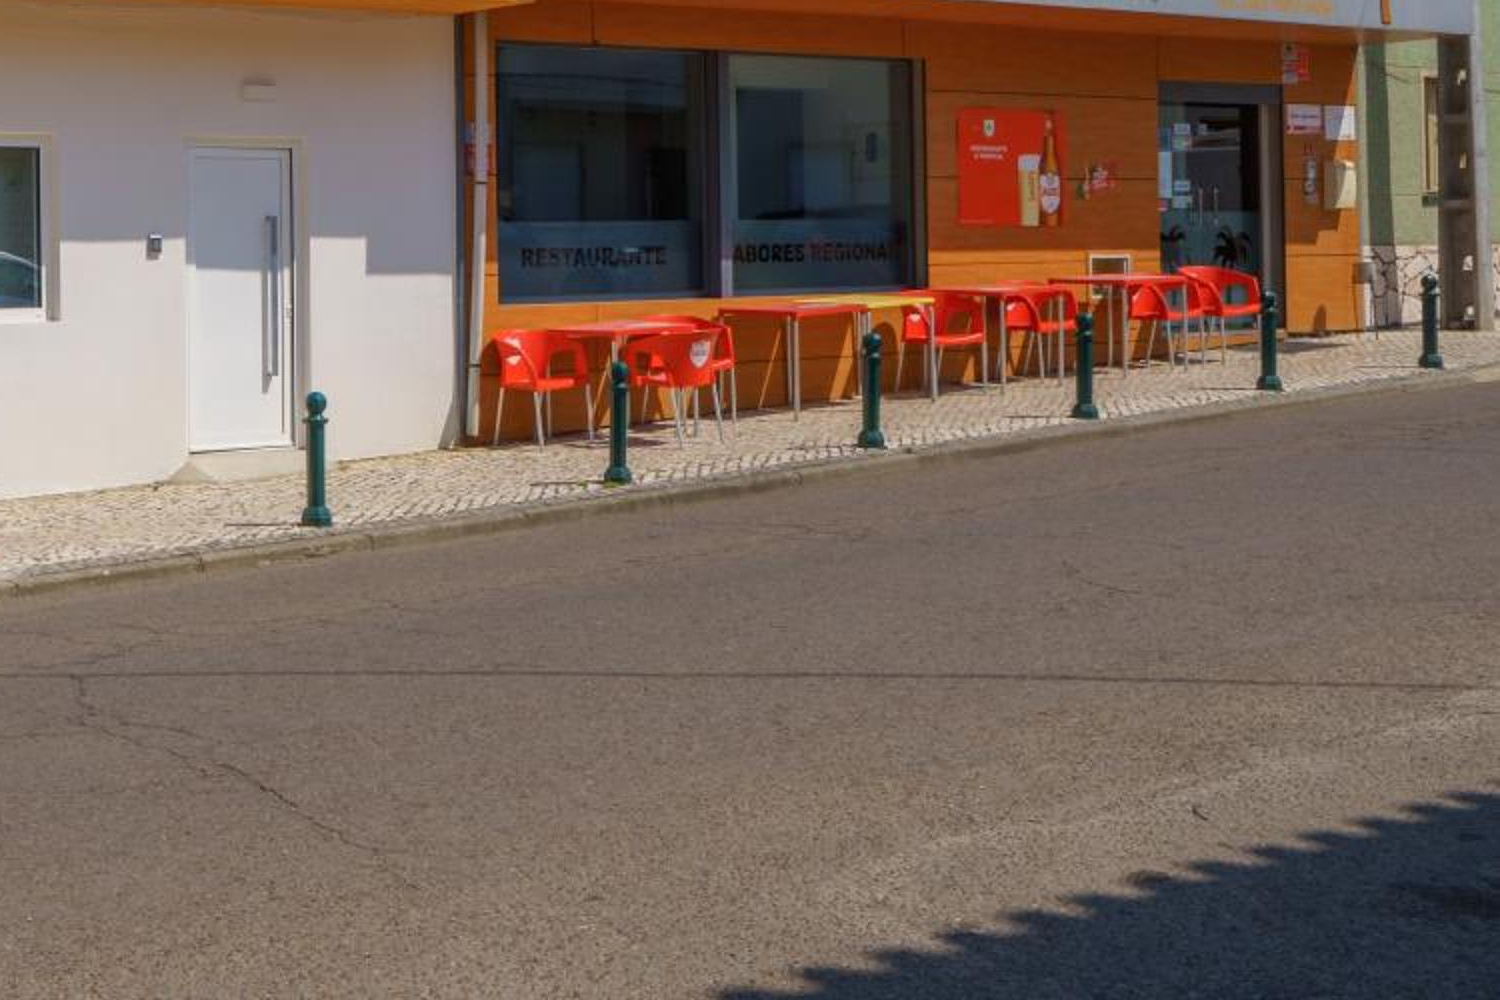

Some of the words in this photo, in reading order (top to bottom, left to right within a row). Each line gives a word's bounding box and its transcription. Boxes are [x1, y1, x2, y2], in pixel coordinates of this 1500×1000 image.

[520, 246, 667, 268] RESTAURANTE
[733, 242, 805, 263] ABORES
[809, 242, 890, 262] REGIONA
